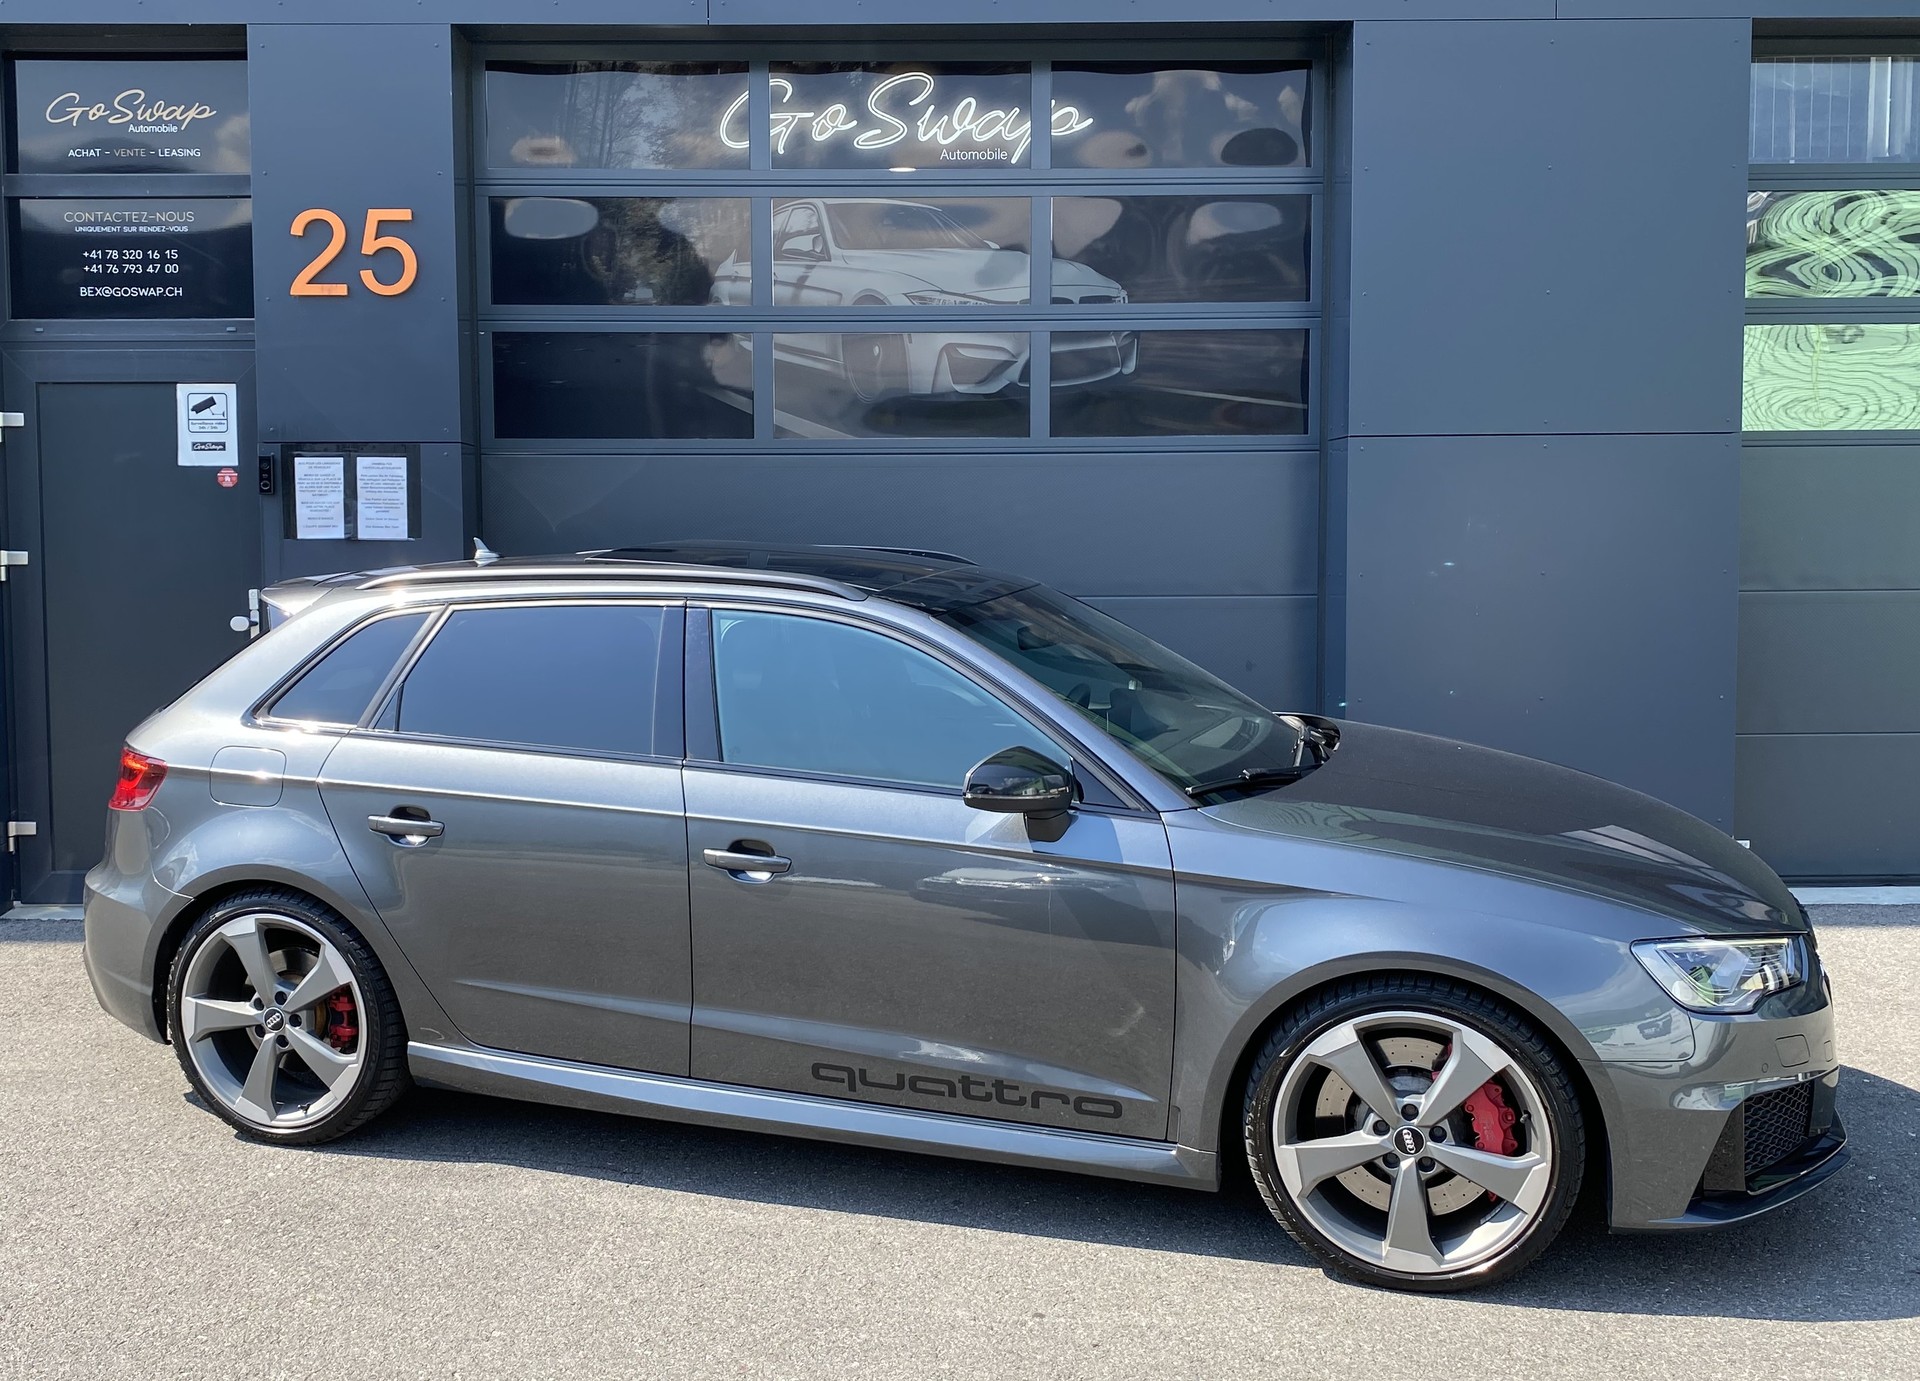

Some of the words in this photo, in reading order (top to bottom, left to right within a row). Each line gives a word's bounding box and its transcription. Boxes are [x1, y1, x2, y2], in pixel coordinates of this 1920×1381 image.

[128, 124, 178, 133] Automobile
[68, 148, 102, 158] ACHAT
[113, 148, 147, 158] VENTE
[158, 148, 201, 158] LEASING
[940, 148, 1008, 161] Automobile
[63, 211, 195, 223] CONTACTEZ-NOUS
[75, 225, 121, 233] UNIQUEMENT
[123, 225, 137, 233] SUR
[138, 225, 189, 233] RENDEZ-VOUS
[82, 249, 102, 260] +41
[105, 249, 119, 260] 78
[122, 249, 143, 260] 320
[147, 249, 161, 260] 16
[164, 249, 179, 260] 15
[289, 208, 418, 296] 25
[83, 263, 103, 274] +41
[106, 263, 119, 274] 76
[122, 263, 143, 274] 793
[146, 263, 161, 274] 47
[164, 263, 179, 274] 00
[79, 286, 183, 297] BEX@GOSWAP.CH
[811, 1062, 1123, 1119] quattro
